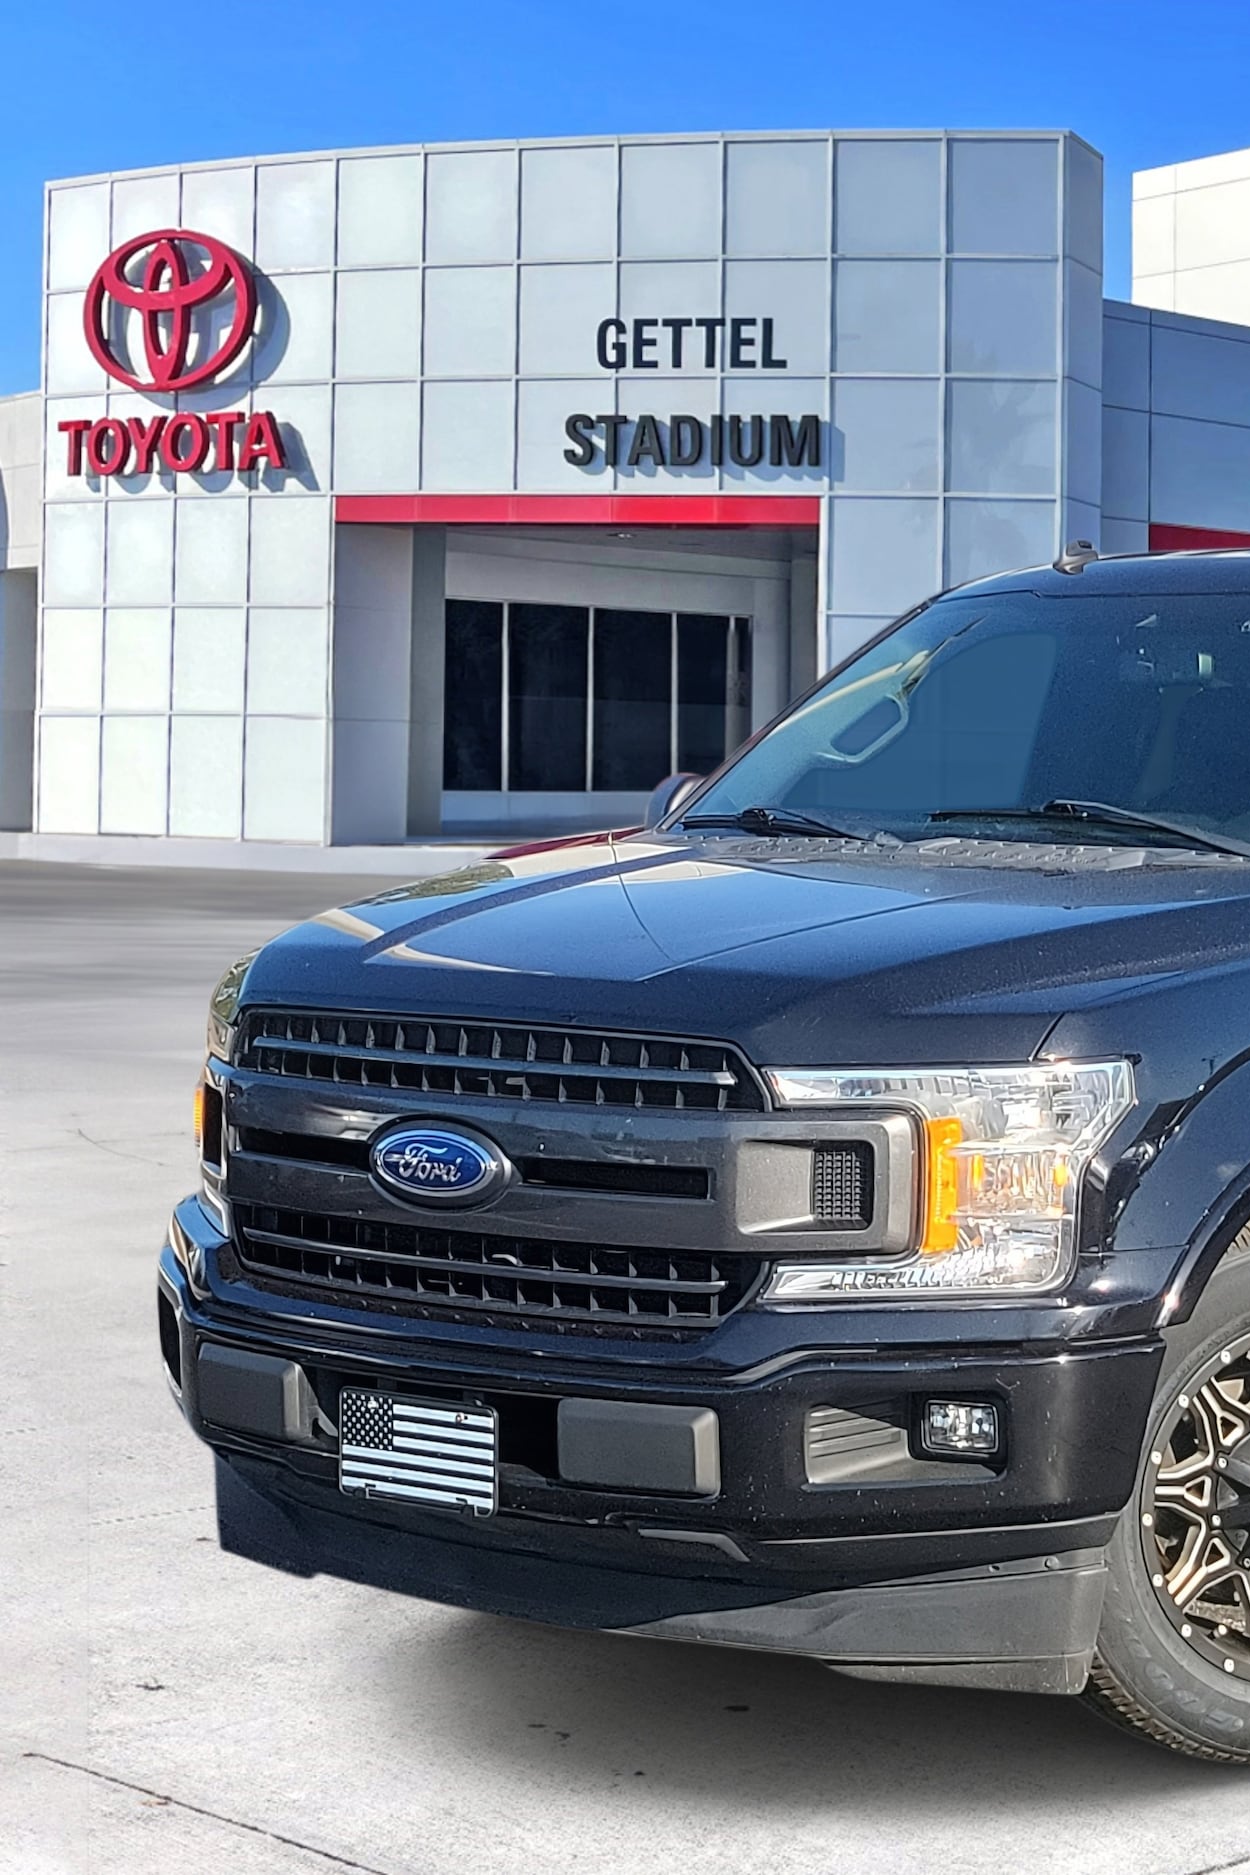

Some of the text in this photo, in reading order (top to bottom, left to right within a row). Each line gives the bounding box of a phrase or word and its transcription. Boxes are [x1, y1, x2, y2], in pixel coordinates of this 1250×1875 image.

[597, 317, 788, 370] GETTEL
[57, 411, 288, 477] TOYOTA
[563, 413, 821, 468] STADIUM
[399, 1143, 463, 1182] Ford
